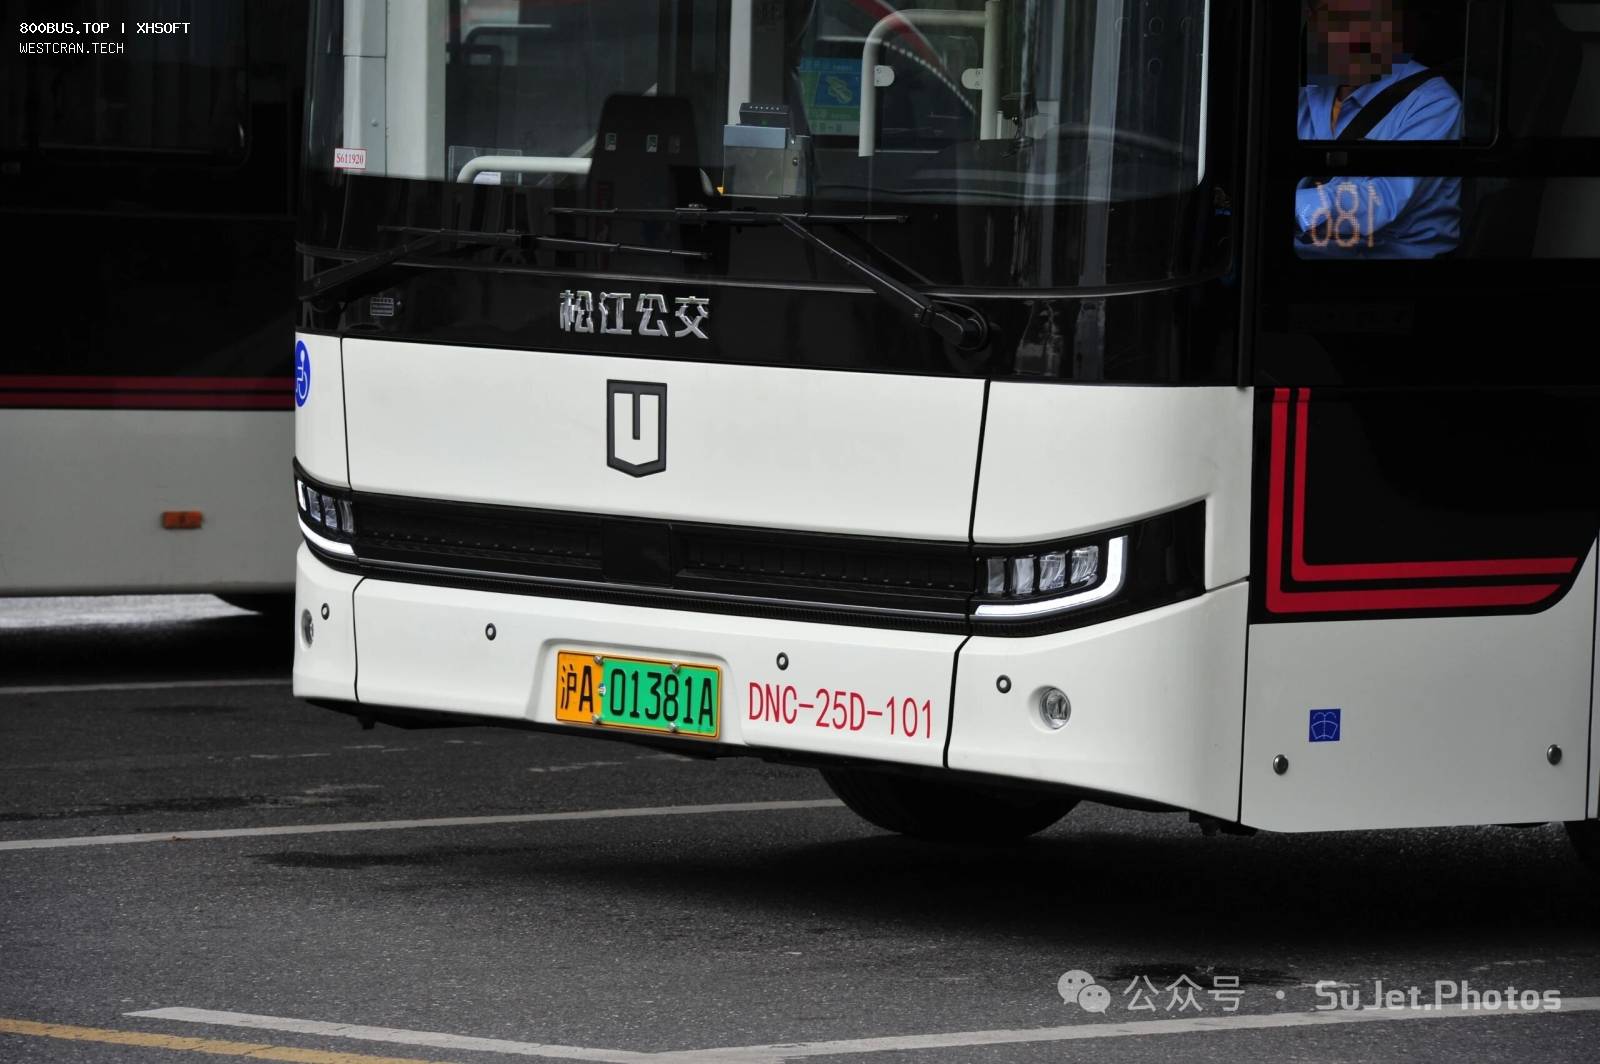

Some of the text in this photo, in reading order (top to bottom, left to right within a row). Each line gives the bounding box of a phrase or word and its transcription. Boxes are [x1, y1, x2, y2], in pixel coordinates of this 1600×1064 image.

[336, 152, 364, 165] S611920
[559, 289, 710, 340] 松江公交
[609, 668, 714, 727] 01381A
[748, 682, 932, 739] DNC-25D-101
